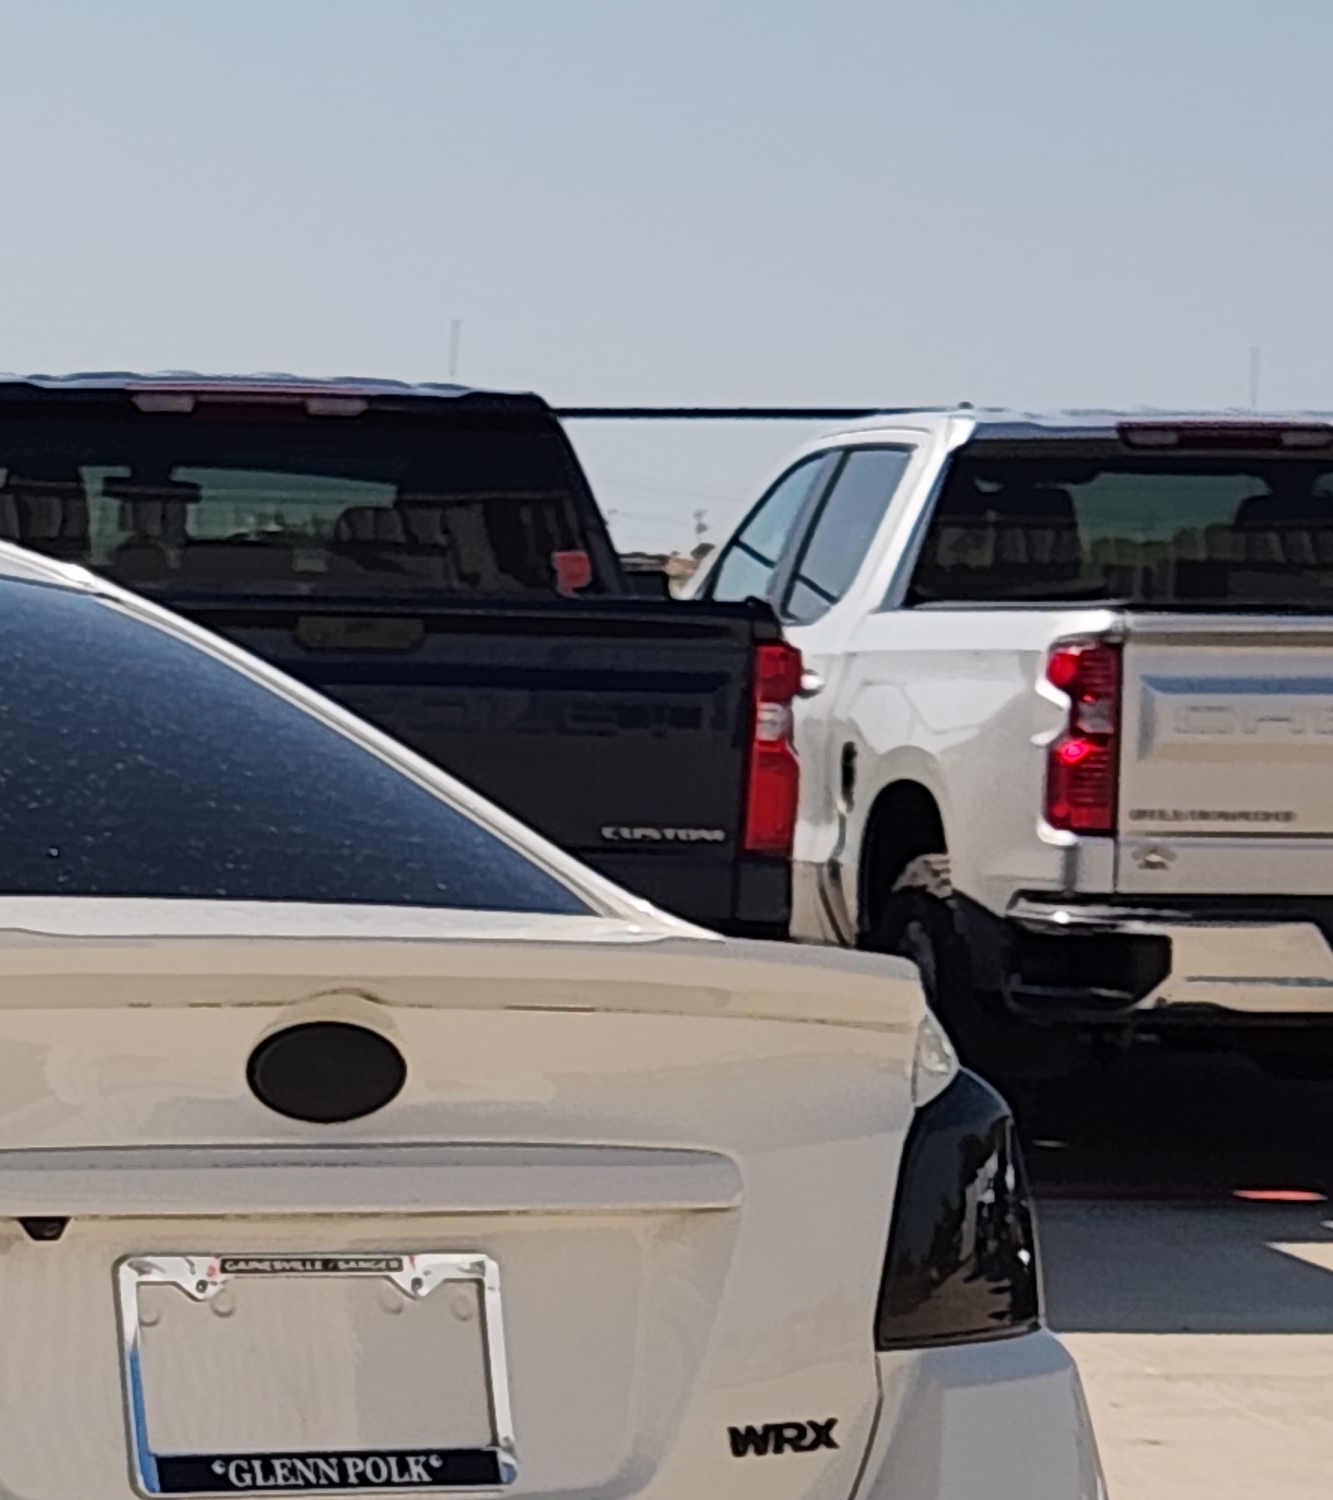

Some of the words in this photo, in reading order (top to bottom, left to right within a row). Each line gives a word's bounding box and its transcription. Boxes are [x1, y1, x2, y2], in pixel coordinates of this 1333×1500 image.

[727, 1418, 840, 1457] WRX
[228, 1457, 340, 1488] GLENN
[343, 1455, 433, 1484] POLK
